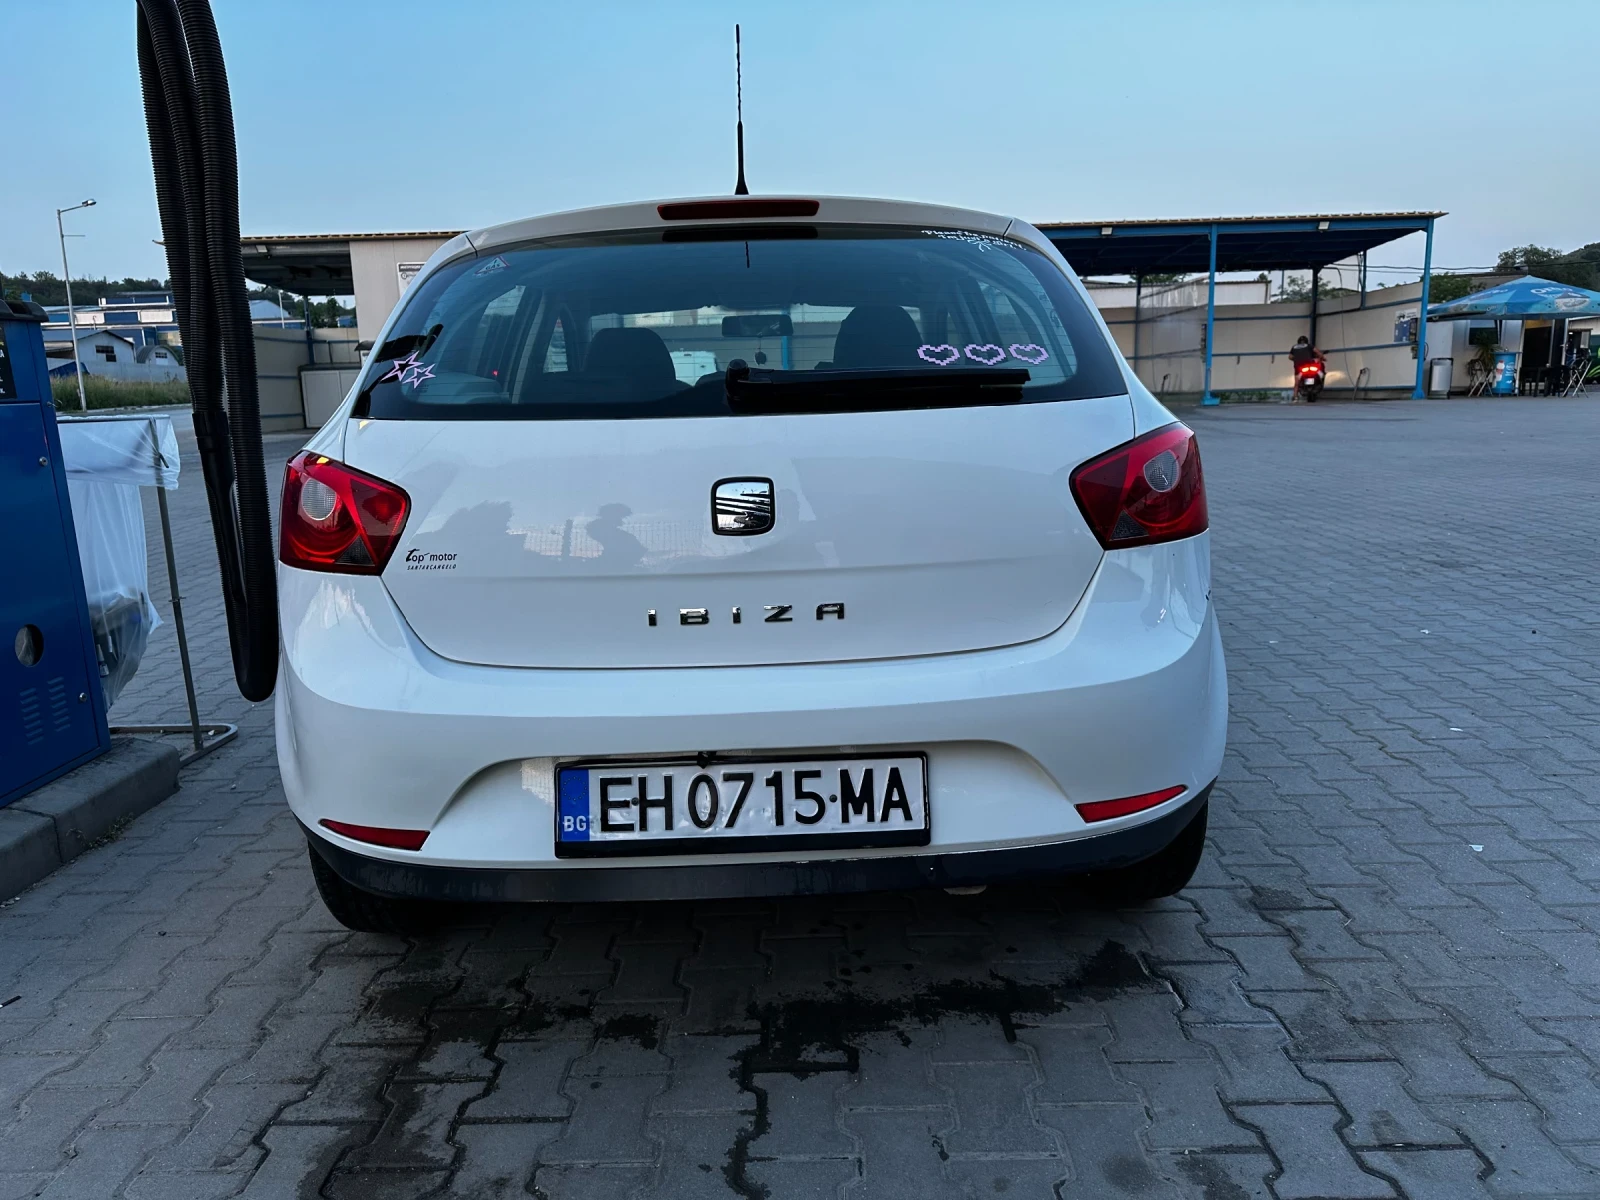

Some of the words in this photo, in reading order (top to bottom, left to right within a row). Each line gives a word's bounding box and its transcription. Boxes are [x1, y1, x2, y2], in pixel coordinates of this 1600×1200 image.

[429, 553, 458, 562] motor
[647, 602, 845, 627] IBIZA
[563, 815, 588, 832] BG
